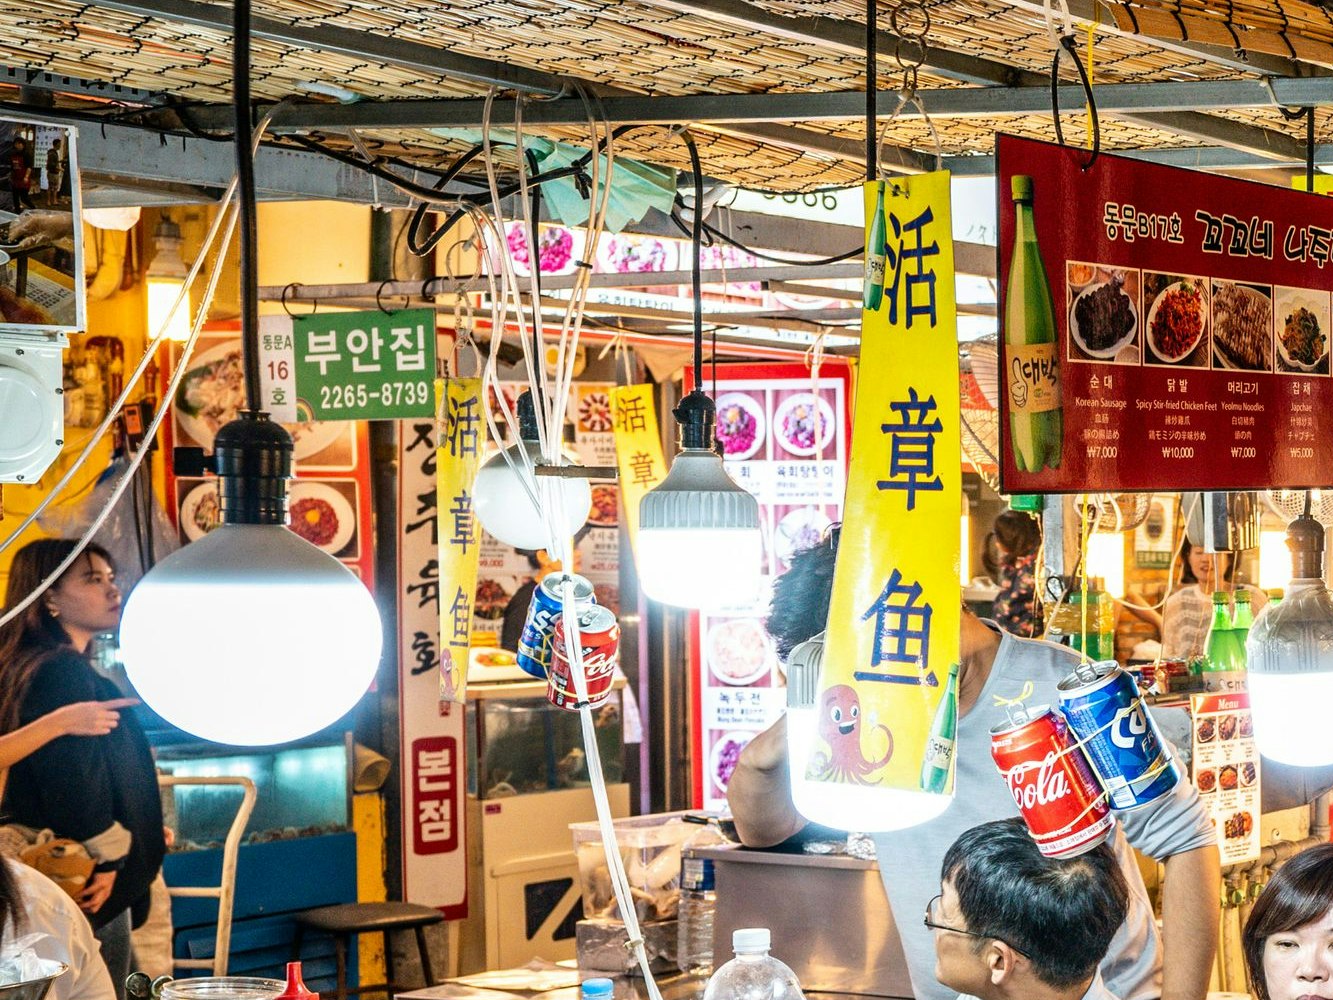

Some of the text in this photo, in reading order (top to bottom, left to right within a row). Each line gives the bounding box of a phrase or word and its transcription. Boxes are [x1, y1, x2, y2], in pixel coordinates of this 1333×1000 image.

[1103, 201, 1185, 244] 동문B17호
[1195, 209, 1274, 260] 꼬꼬네
[263, 335, 292, 350] 동문A
[305, 325, 425, 376] 부안집
[267, 361, 289, 381] 16
[320, 381, 428, 409] 2265-8739
[1227, 381, 1259, 395] 머리고기
[271, 387, 287, 406] 호
[1075, 397, 1127, 409] Korean Sausage
[1136, 399, 1217, 411] Spicy Stir-fried Chicken Feet
[1221, 401, 1265, 412] Yeolmu Noodles
[1290, 402, 1312, 413] Japchae
[853, 206, 945, 688] 活章鱼
[1087, 447, 1117, 459] ₩7,000
[1162, 447, 1194, 459] ₩10,000
[1231, 447, 1256, 458] ₩7,000
[1218, 698, 1239, 710] Menu
[418, 747, 450, 843] 본점
